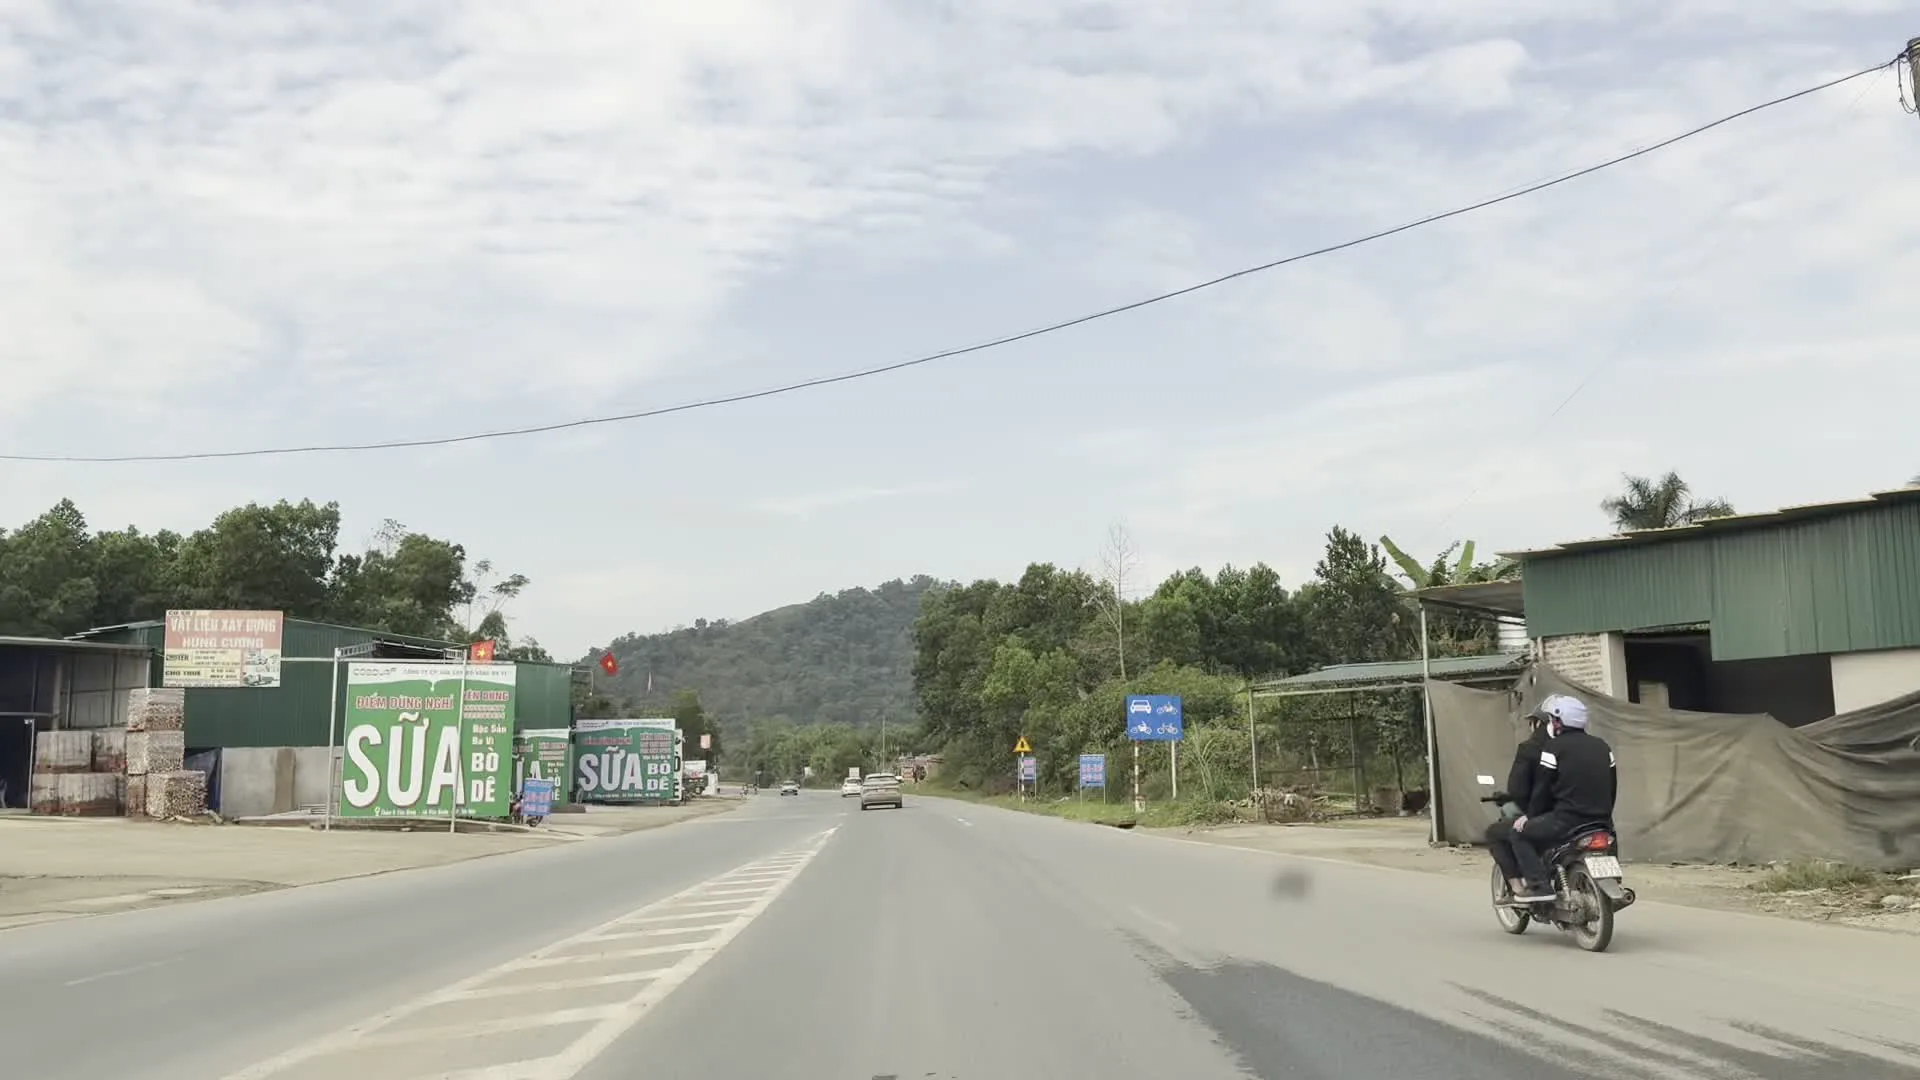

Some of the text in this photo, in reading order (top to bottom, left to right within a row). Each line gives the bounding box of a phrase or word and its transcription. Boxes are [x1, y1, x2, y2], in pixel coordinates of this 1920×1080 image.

[355, 692, 387, 710] ĐIỂM
[425, 694, 455, 710] NGHỈ
[344, 711, 466, 808] SỮA
[471, 747, 499, 773] BÒ
[578, 746, 644, 792] SỮA
[647, 759, 671, 775] BÒ
[470, 776, 496, 803] DÊ
[646, 778, 669, 791] DÊ
